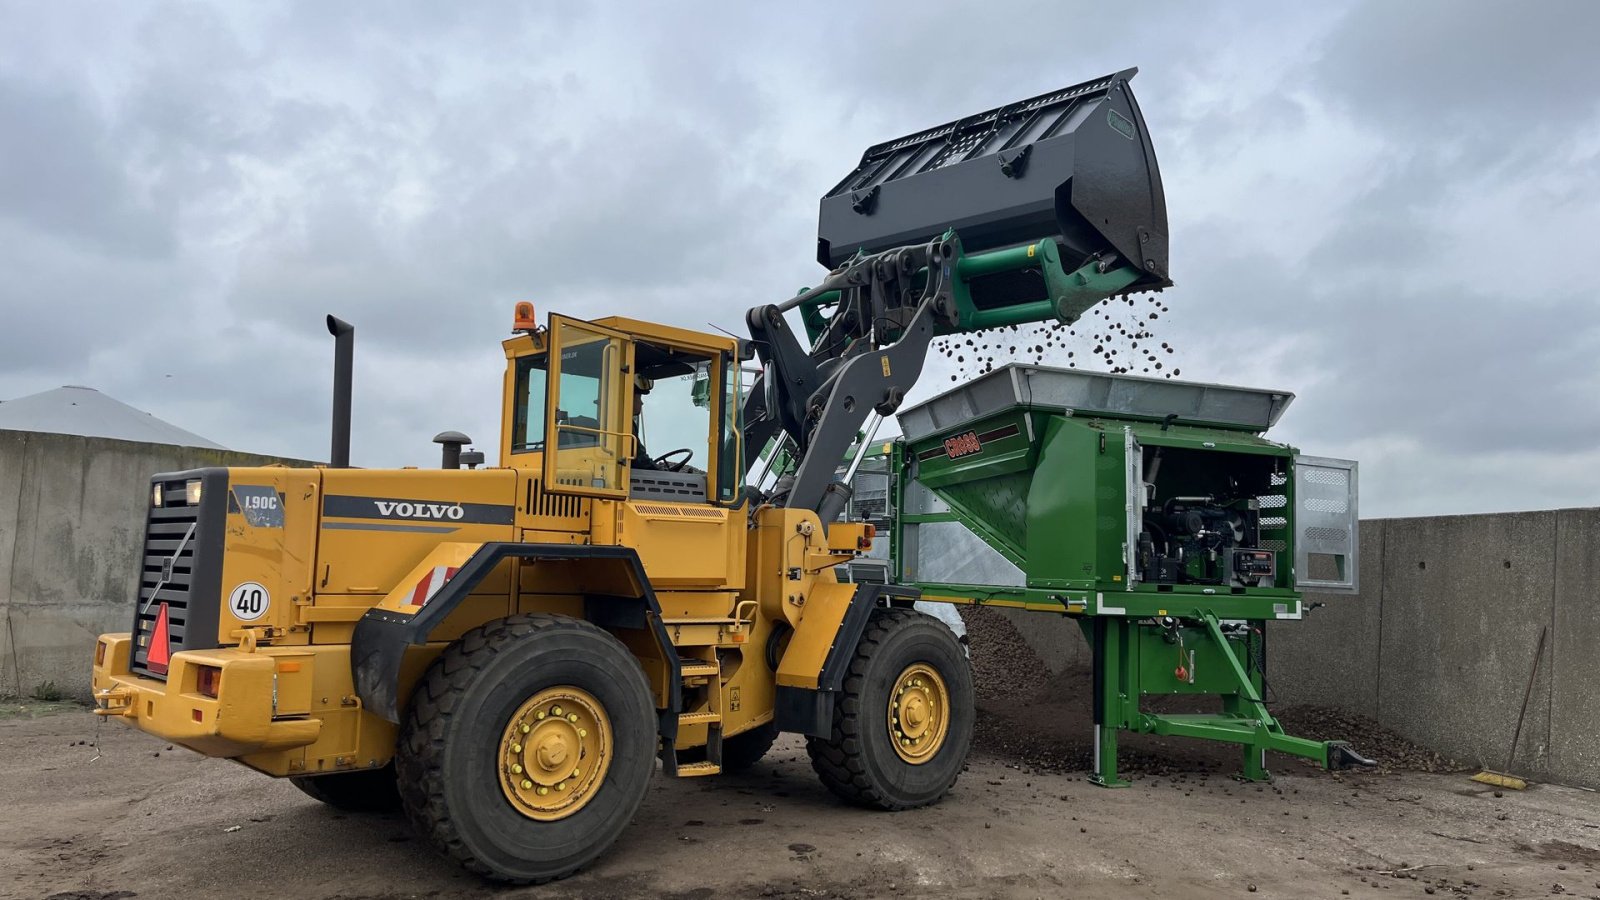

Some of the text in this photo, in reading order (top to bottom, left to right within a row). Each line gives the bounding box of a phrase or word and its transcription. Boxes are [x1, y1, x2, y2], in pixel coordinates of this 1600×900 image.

[245, 495, 277, 510] L90C
[374, 501, 464, 520] VOLVO
[236, 589, 262, 614] 40
